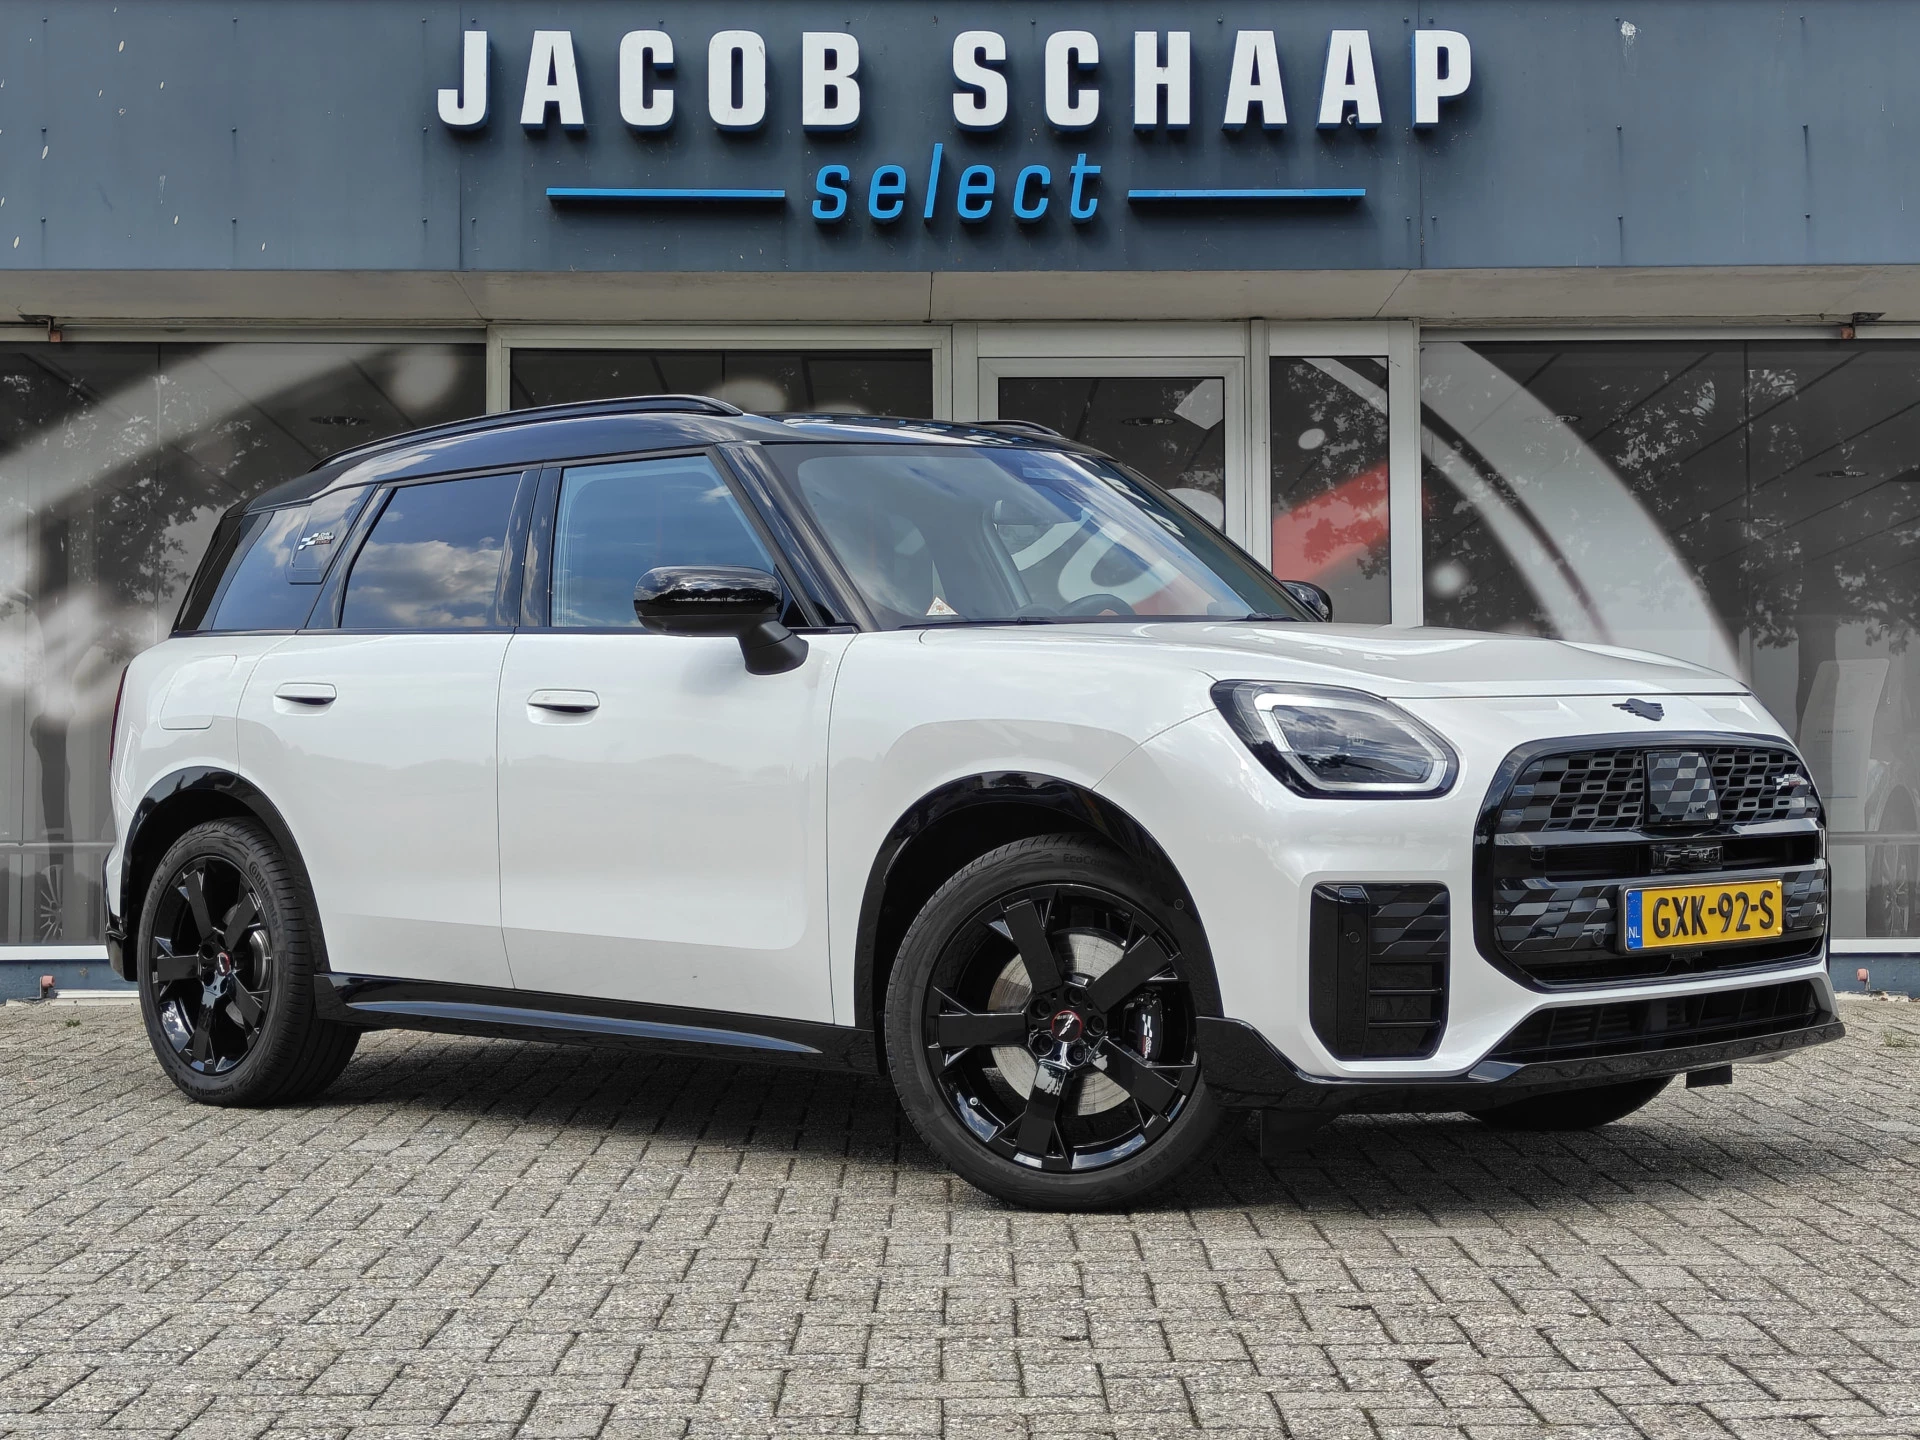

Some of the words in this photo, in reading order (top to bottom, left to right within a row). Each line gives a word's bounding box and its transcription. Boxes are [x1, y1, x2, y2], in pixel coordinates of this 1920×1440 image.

[437, 30, 861, 130] JACOB
[951, 30, 1472, 130] SCHAAP
[812, 143, 1102, 222] select
[1628, 926, 1641, 939] NL
[1652, 889, 1775, 939] GXK-92-S
